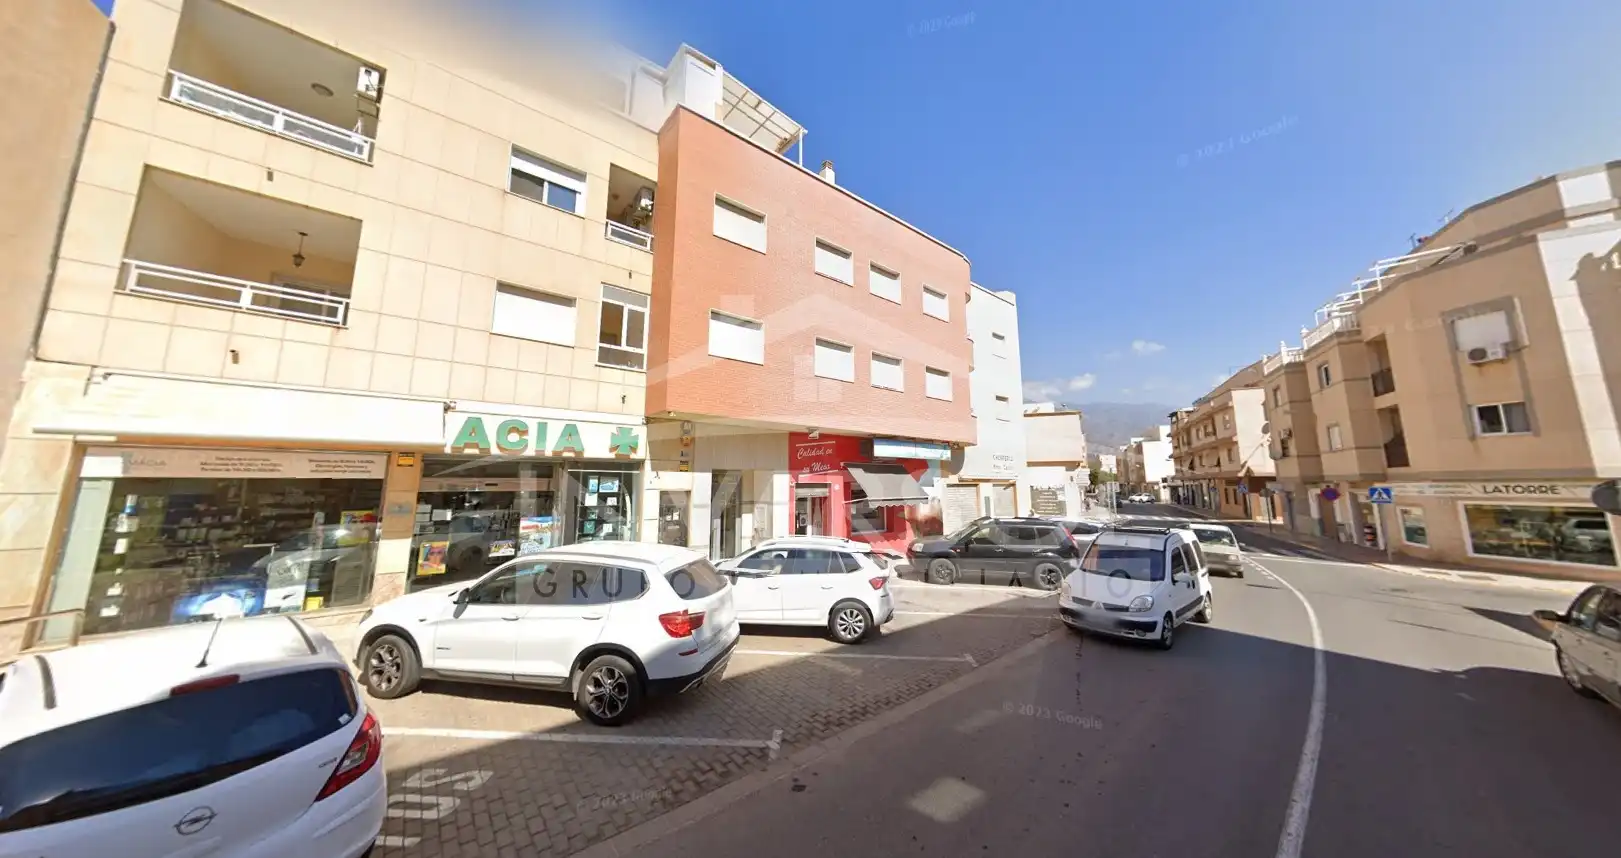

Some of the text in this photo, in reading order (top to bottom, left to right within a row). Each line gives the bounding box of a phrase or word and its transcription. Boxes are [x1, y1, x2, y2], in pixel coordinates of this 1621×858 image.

[450, 416, 585, 457] ACIA
[812, 462, 831, 472] Mesa
[1483, 484, 1561, 495] LATORRE
